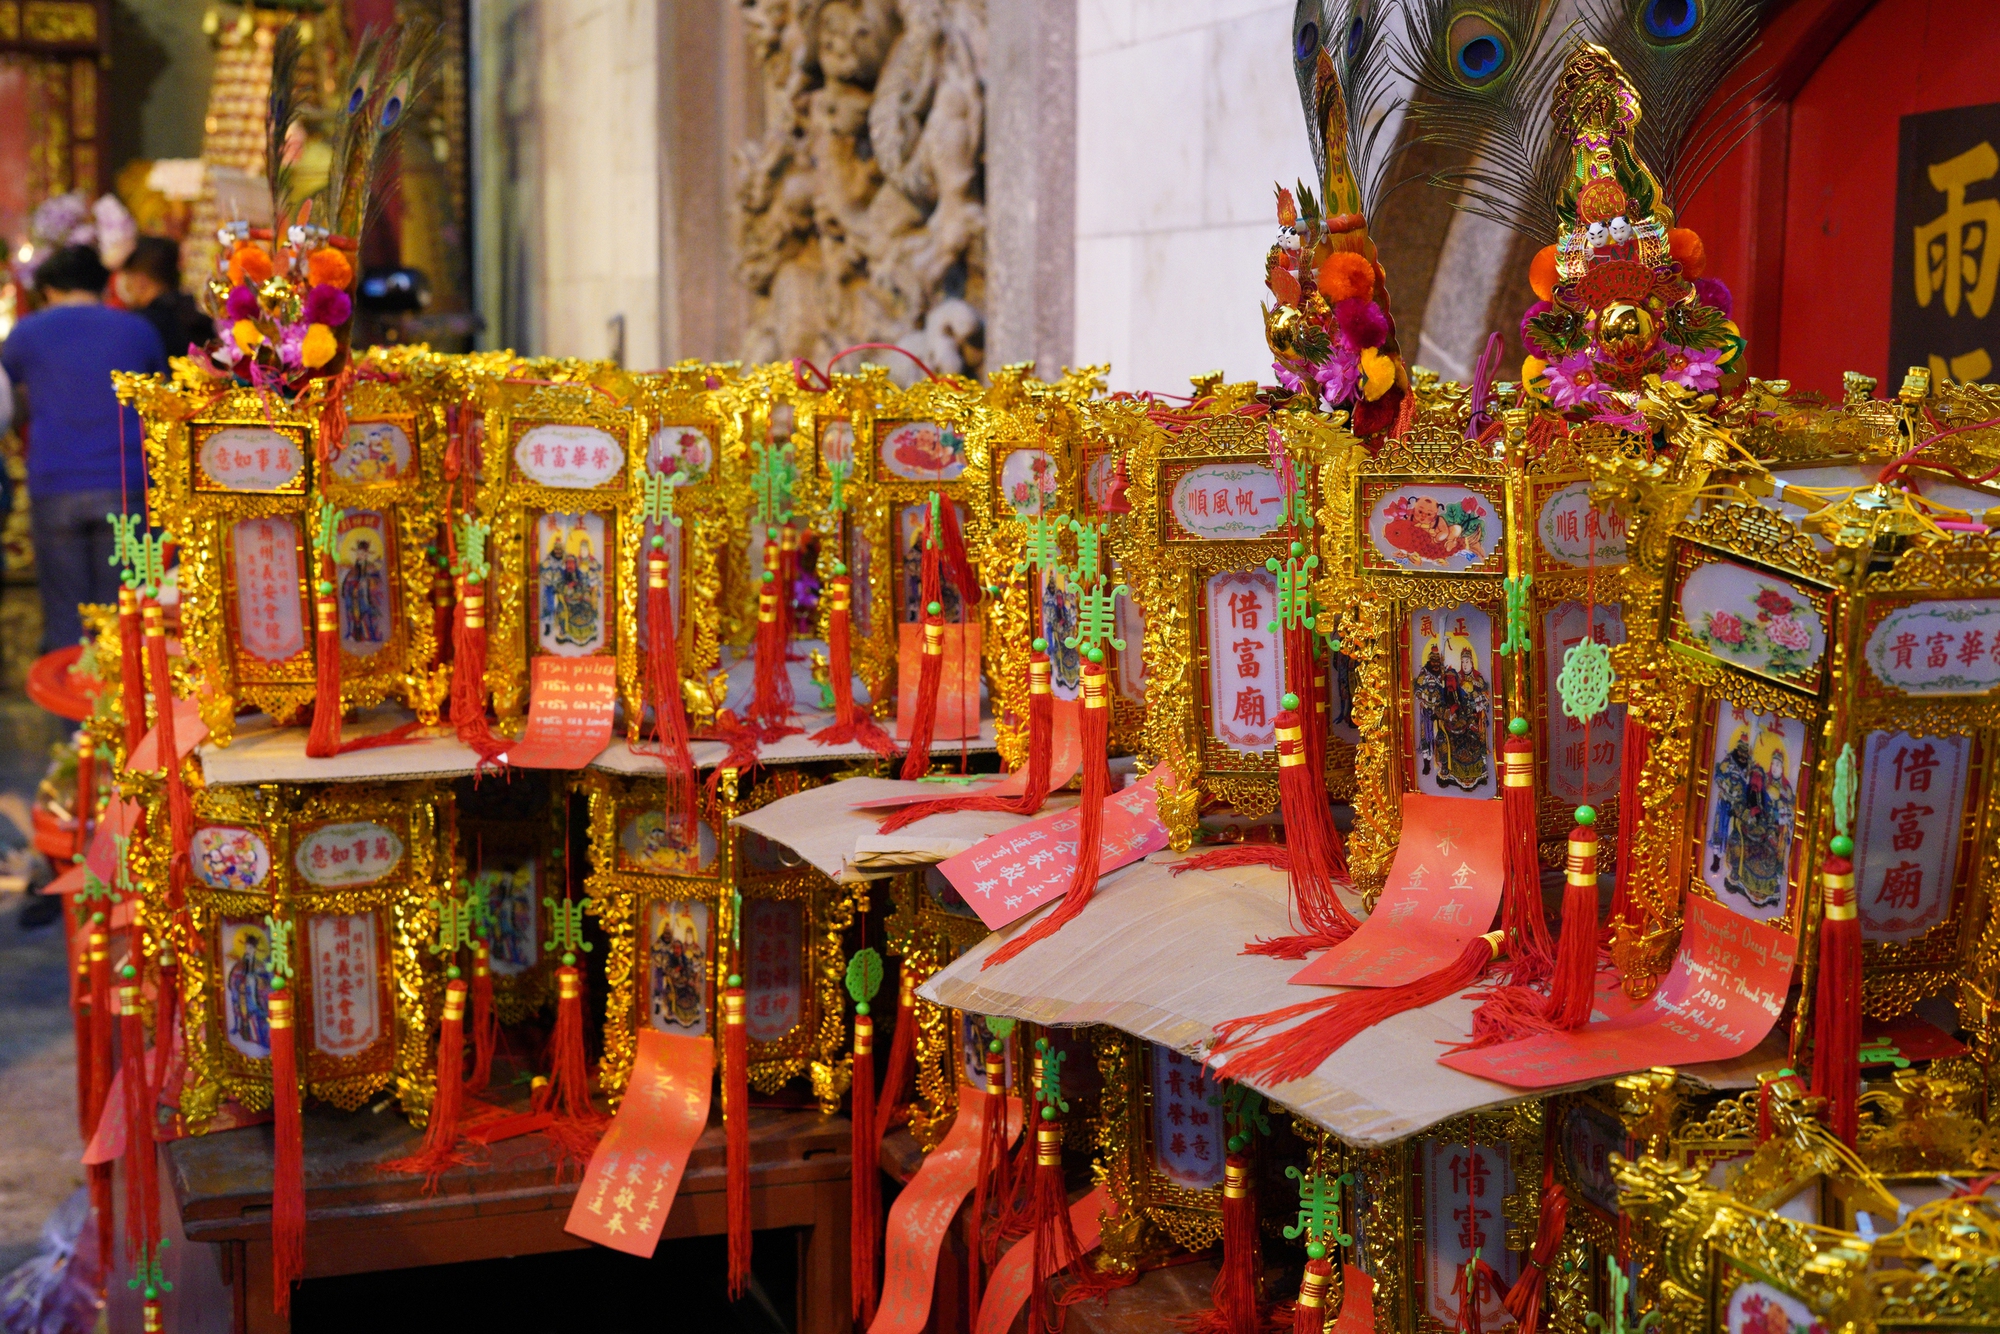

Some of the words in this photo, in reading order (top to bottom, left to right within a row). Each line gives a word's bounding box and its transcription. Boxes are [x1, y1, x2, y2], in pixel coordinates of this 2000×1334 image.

[1227, 590, 1266, 729] 借富廟
[1592, 622, 1616, 766] 馬成功
[1874, 743, 1940, 910] 借富廟
[1691, 987, 1727, 1010] 1990
[1188, 1060, 1210, 1161] 祥如意
